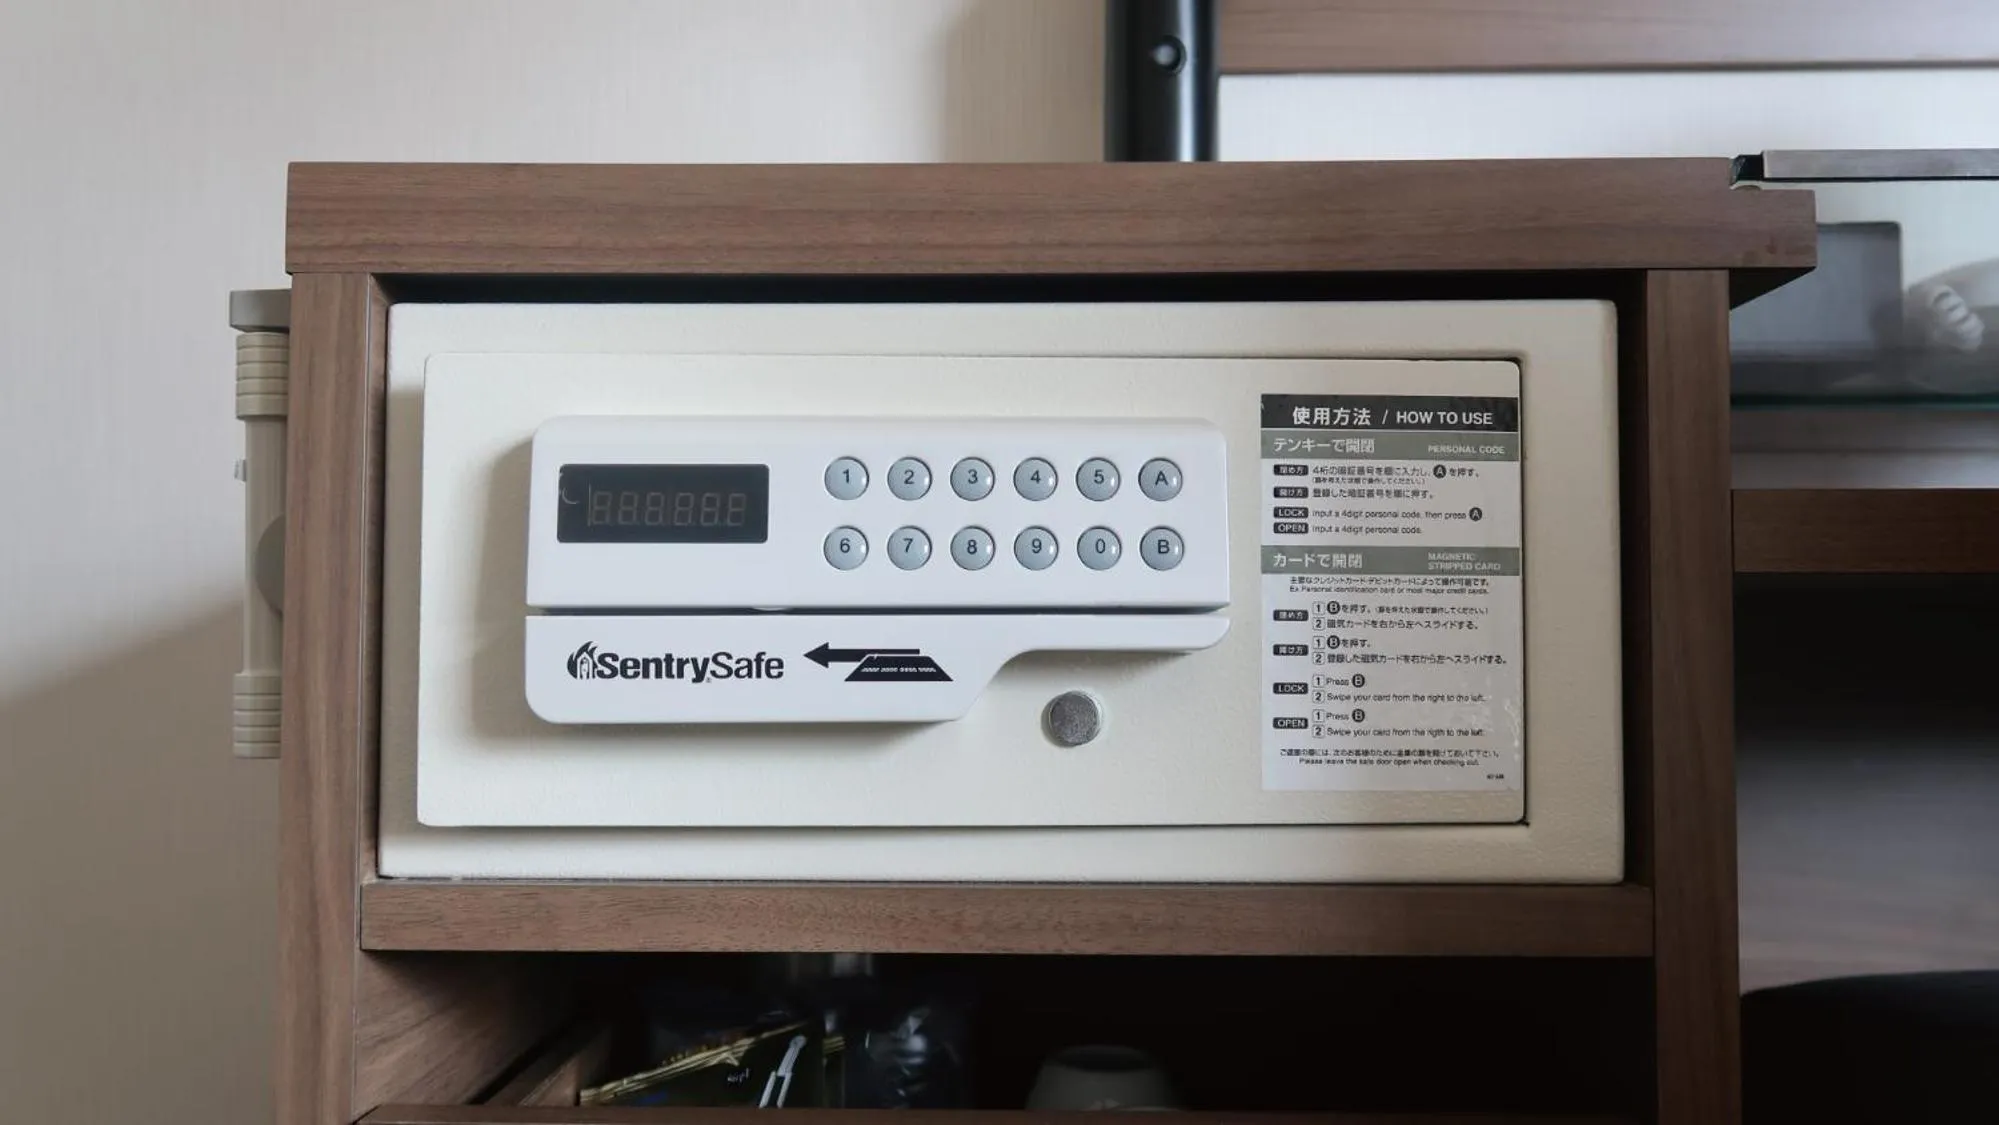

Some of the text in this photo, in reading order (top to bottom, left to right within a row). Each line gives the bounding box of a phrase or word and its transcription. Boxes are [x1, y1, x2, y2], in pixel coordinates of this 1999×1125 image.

[1292, 406, 1493, 426] 使用方法 / HOW TO USE
[1273, 438, 1376, 453] テンキーで開閉
[1428, 445, 1505, 454] PERSONAL CODE
[843, 469, 1168, 486] 1 2 3 4 5 A
[1278, 508, 1305, 517] LOCK
[1277, 523, 1306, 533] OPEN
[840, 538, 1169, 554] 6 7 8 9 0 B
[1273, 553, 1363, 569] カードで開閉
[1428, 552, 1476, 561] MAGNETIC
[1428, 562, 1501, 571] STRIPPED CARD
[596, 651, 785, 683] SentrySafe
[1326, 677, 1349, 686] Press
[1278, 685, 1305, 693] LOCK
[1327, 692, 1351, 702] Swipe
[1353, 694, 1371, 703] your
[1373, 693, 1390, 701] card
[1392, 693, 1410, 701] from
[1447, 694, 1455, 702] to
[1326, 711, 1349, 721] Press
[1277, 719, 1305, 728] OPEN
[1327, 727, 1351, 737] Swipe
[1353, 729, 1371, 738] your
[1373, 728, 1390, 737] card
[1392, 728, 1410, 737] from
[1447, 728, 1455, 737] to
